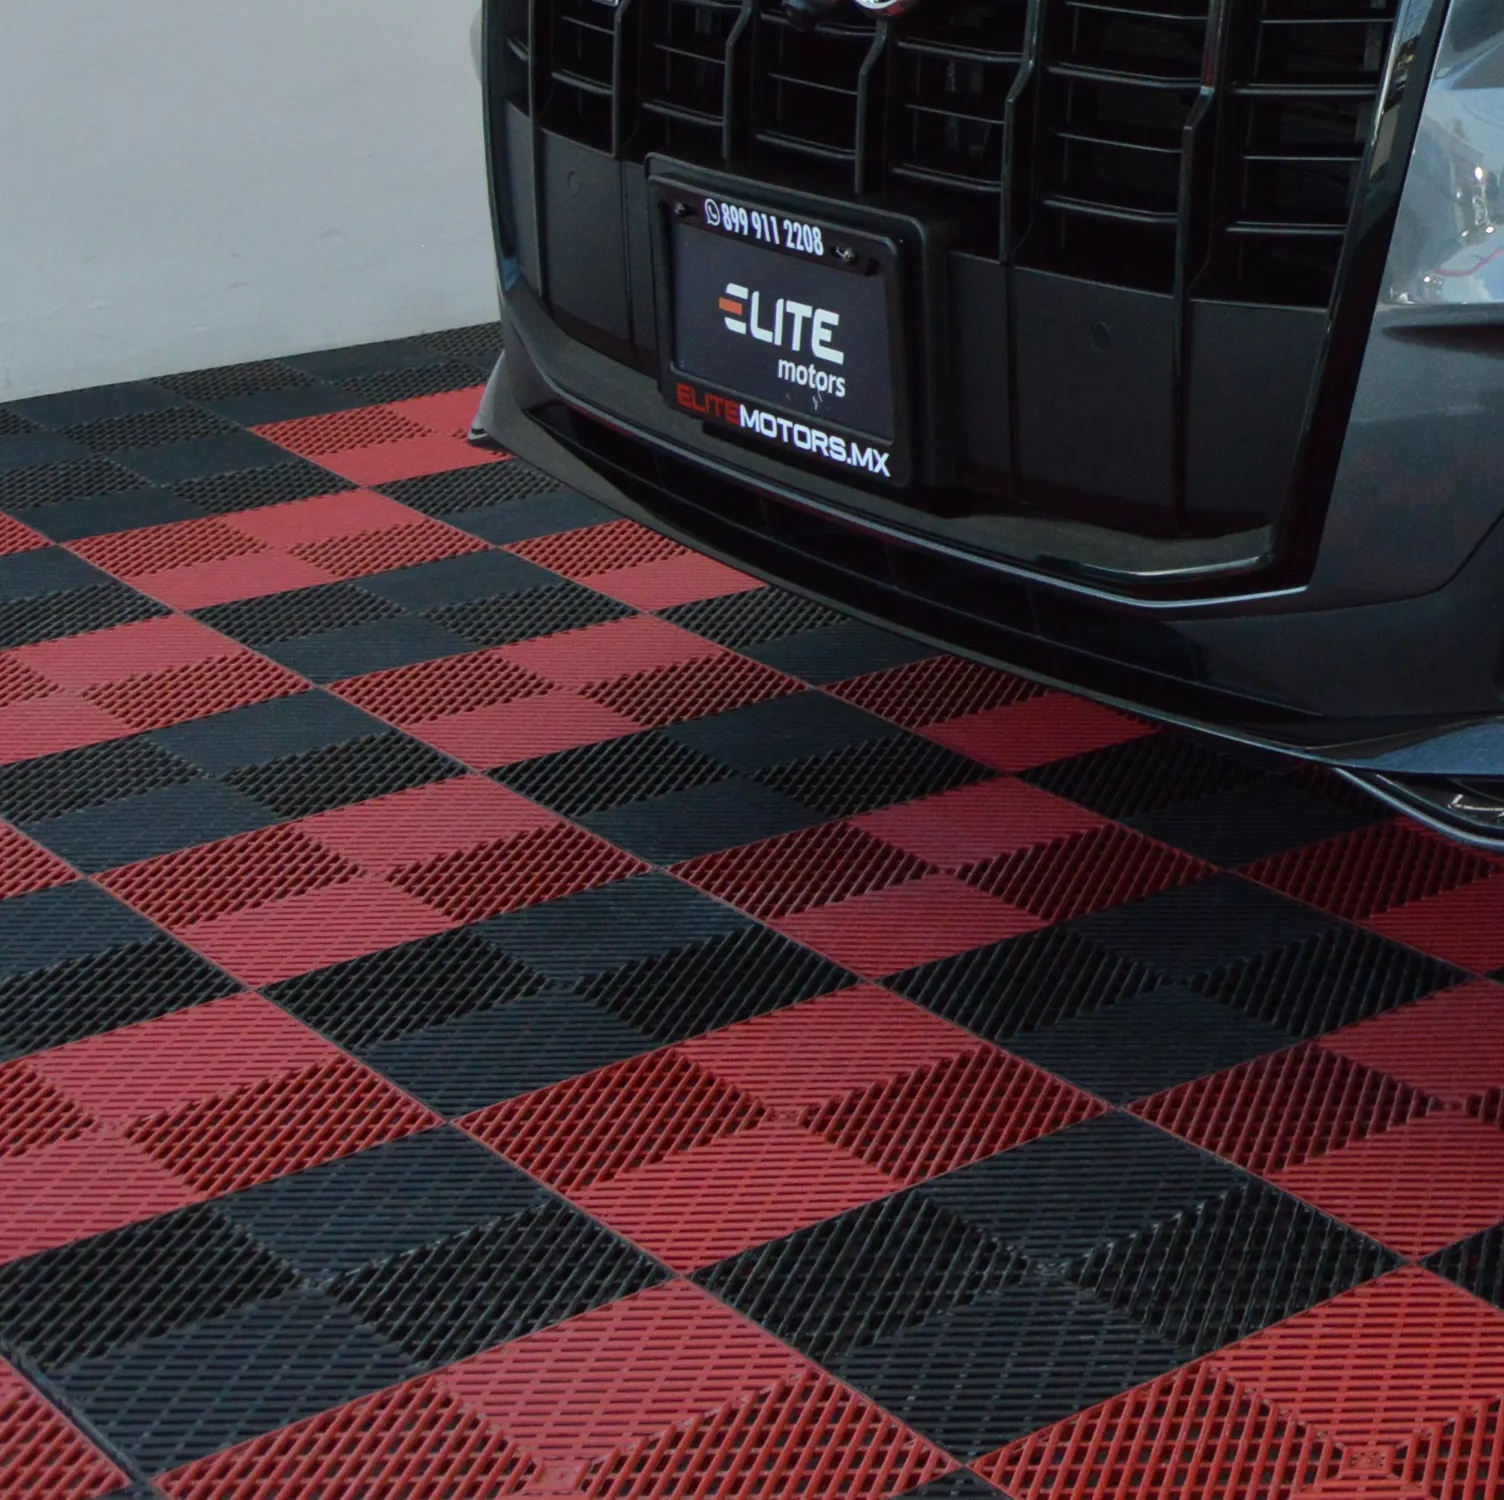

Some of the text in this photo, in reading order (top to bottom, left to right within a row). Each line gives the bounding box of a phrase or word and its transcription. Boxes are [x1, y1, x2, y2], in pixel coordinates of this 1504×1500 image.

[720, 202, 824, 257] 899 911 2208
[719, 283, 845, 364] ELITE
[777, 356, 846, 398] motors
